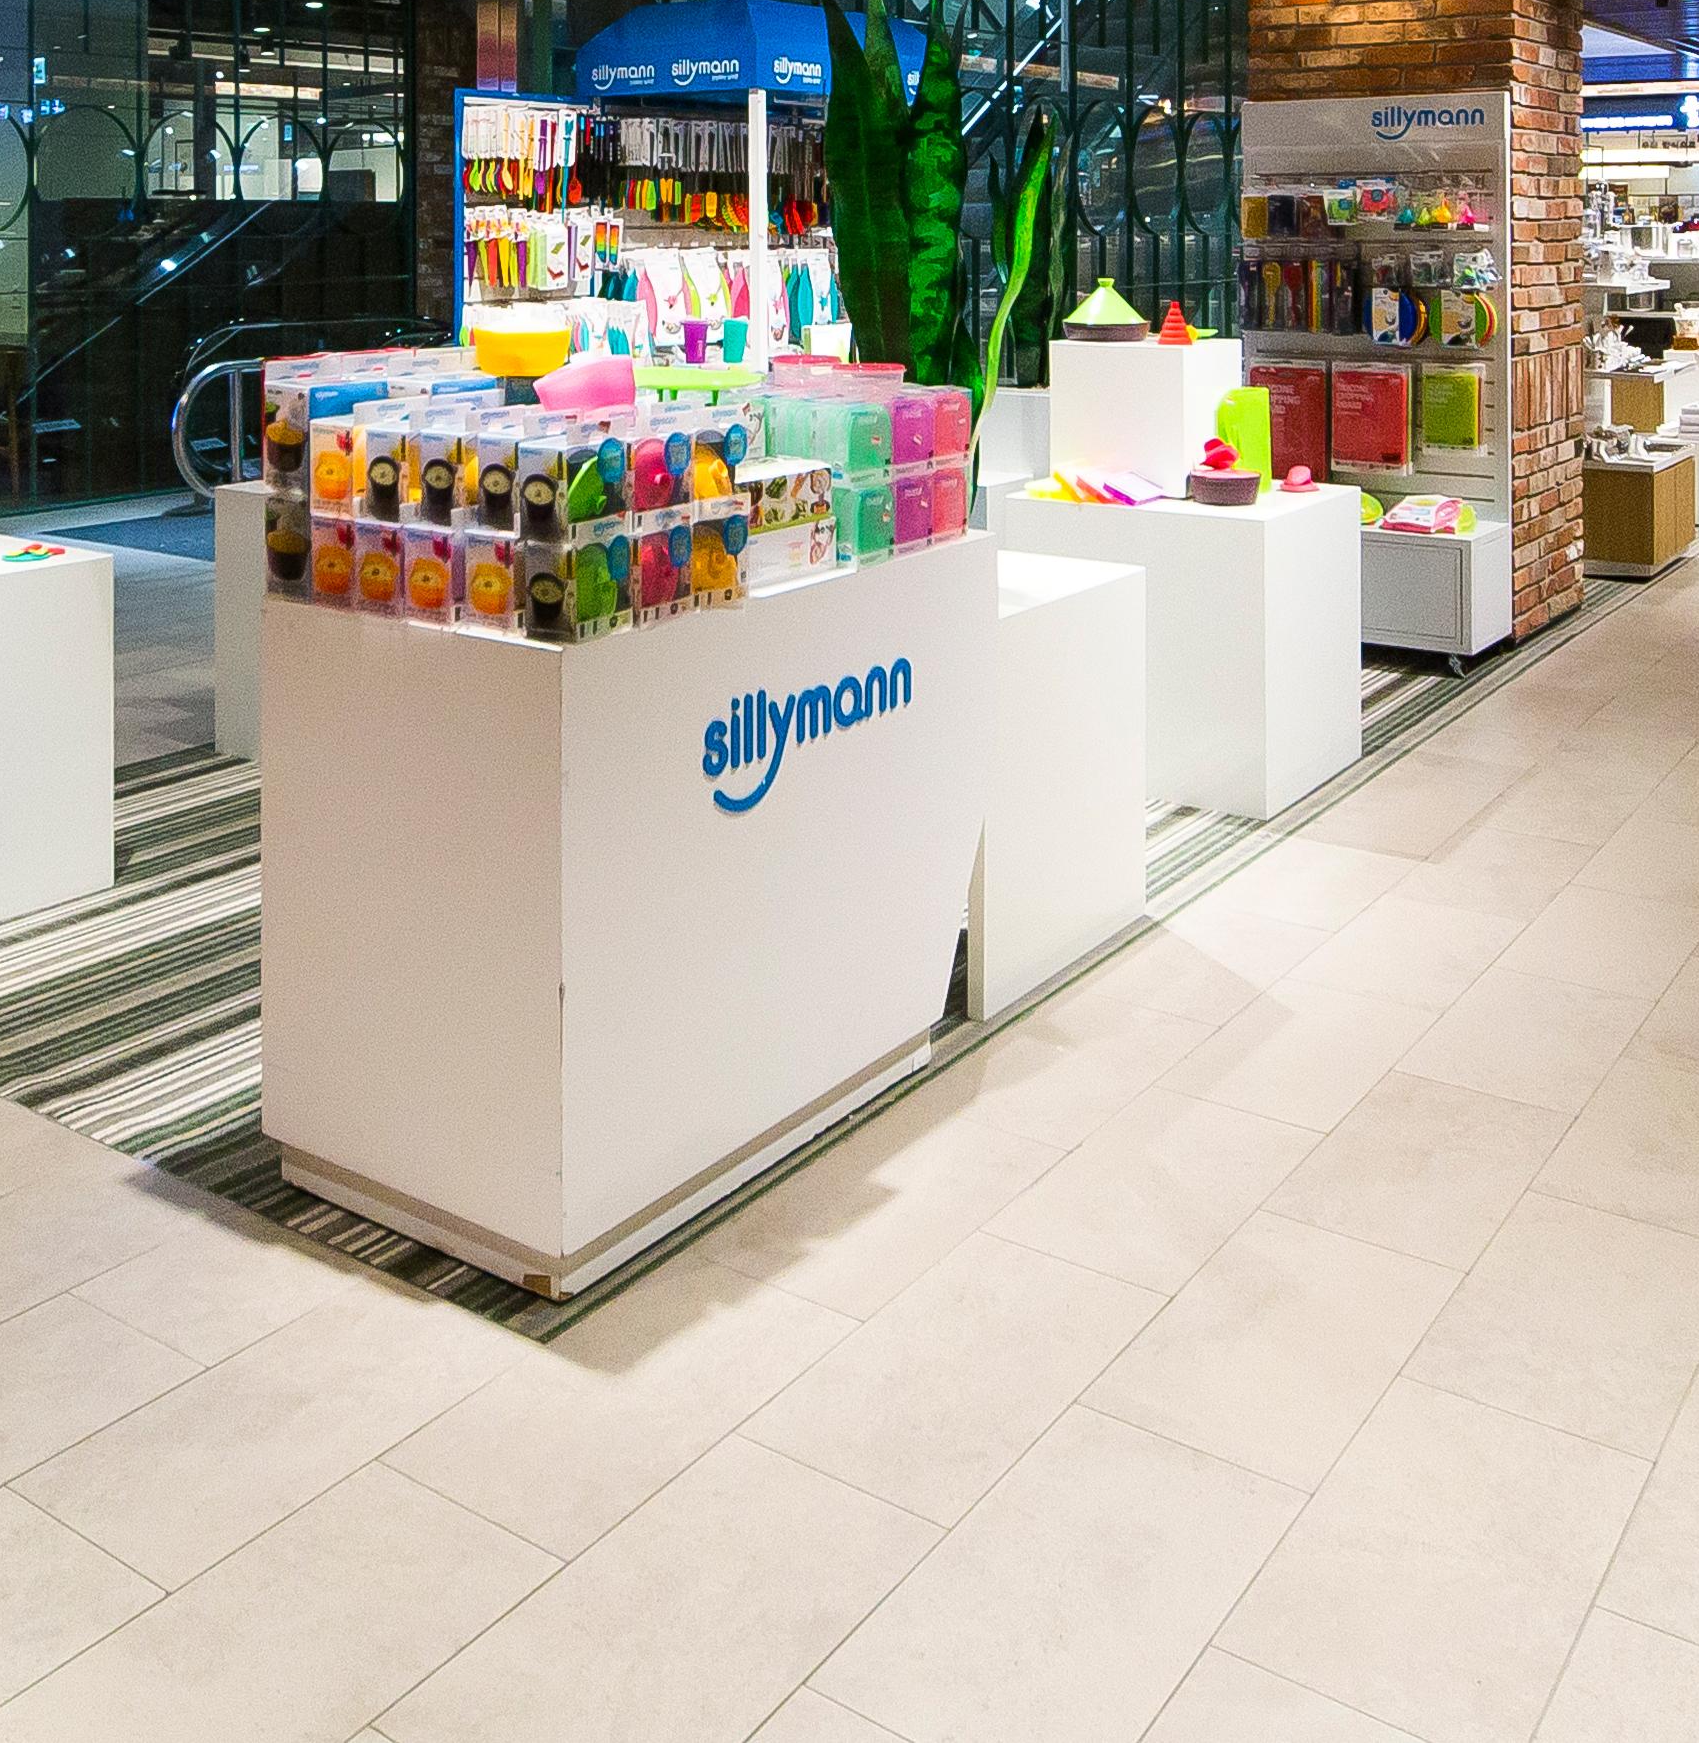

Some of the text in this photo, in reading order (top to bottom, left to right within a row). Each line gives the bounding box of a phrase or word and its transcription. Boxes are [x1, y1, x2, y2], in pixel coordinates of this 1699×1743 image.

[592, 64, 655, 90] sillymann
[671, 59, 739, 86] sillymann
[774, 56, 822, 84] sillymann
[1371, 106, 1485, 140] sillymann
[702, 657, 912, 814] sillymann
